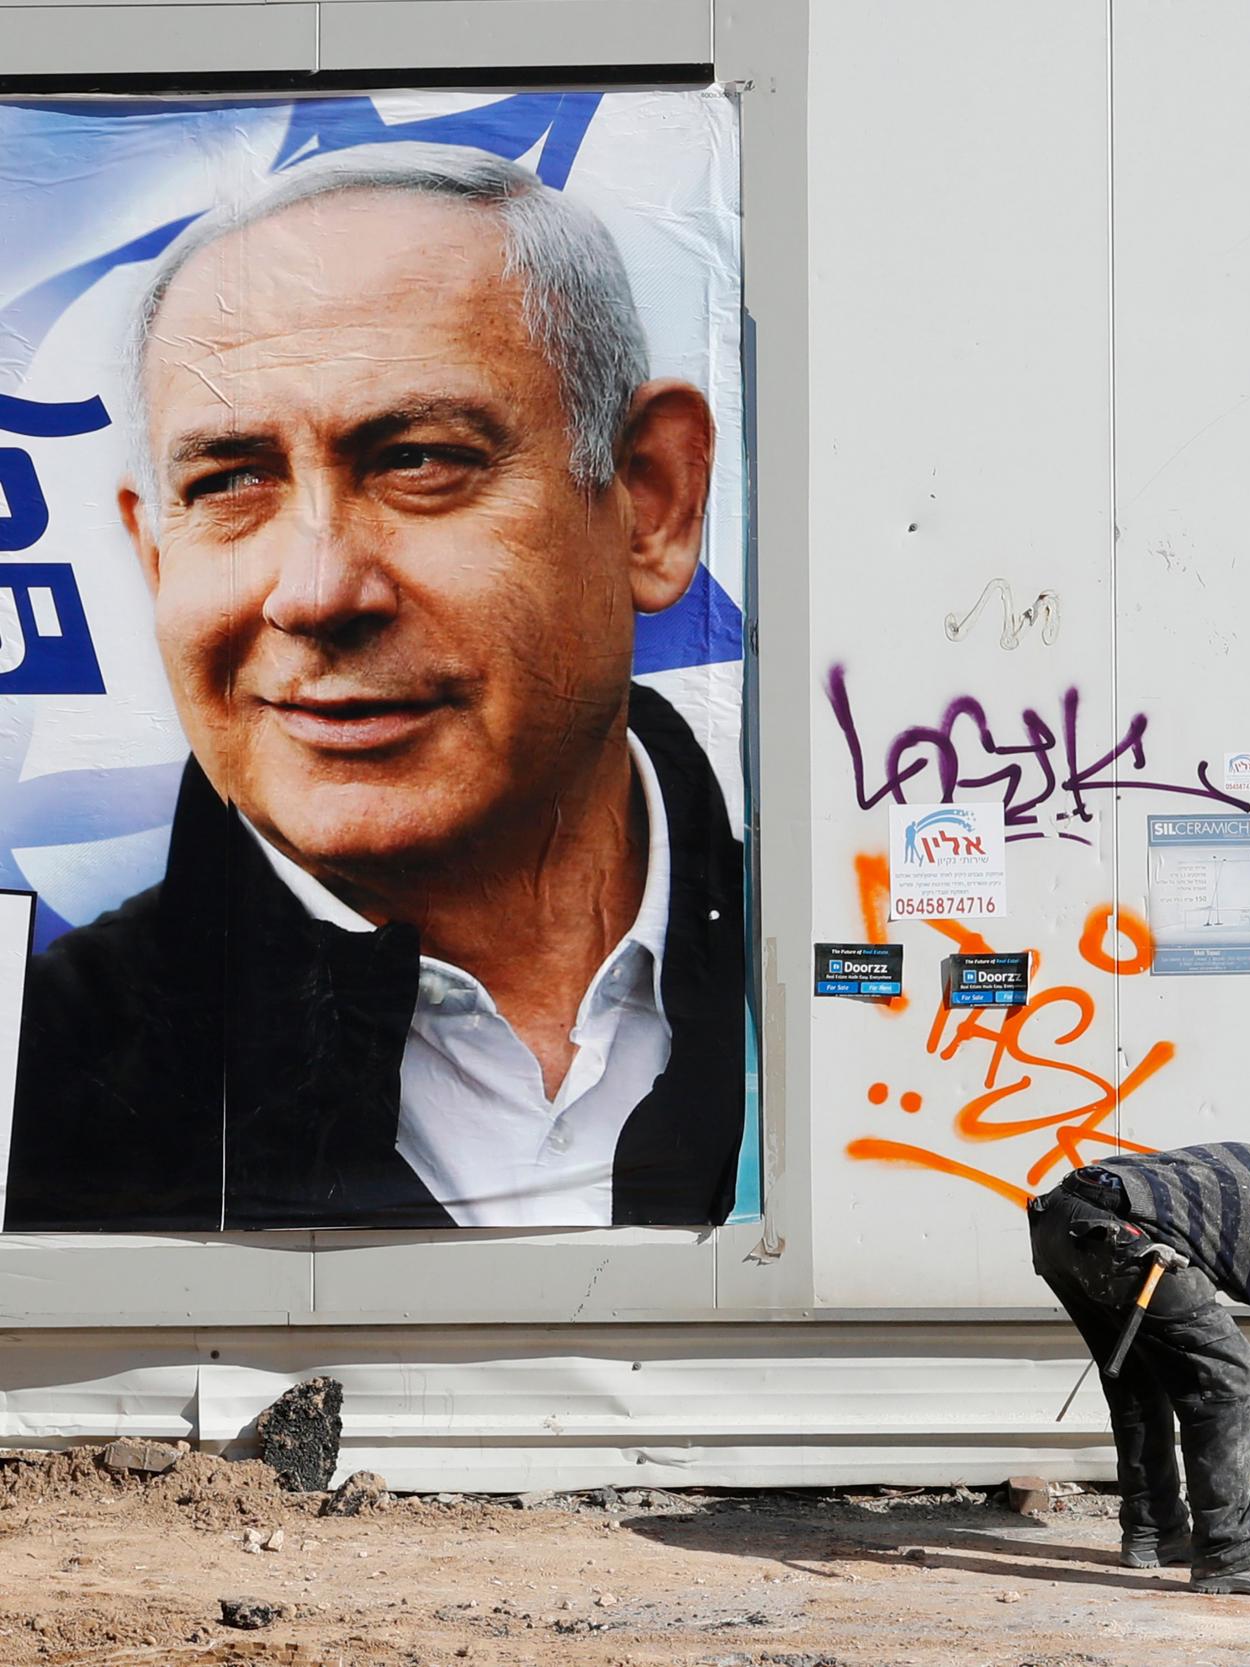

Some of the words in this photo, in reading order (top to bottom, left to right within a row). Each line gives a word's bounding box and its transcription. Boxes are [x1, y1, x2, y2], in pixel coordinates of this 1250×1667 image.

[921, 830, 986, 864] אלין
[959, 856, 989, 865] שירותי
[896, 896, 996, 915] 0545874716
[844, 962, 888, 973] Doorzz
[978, 971, 1022, 982] Doorzz
